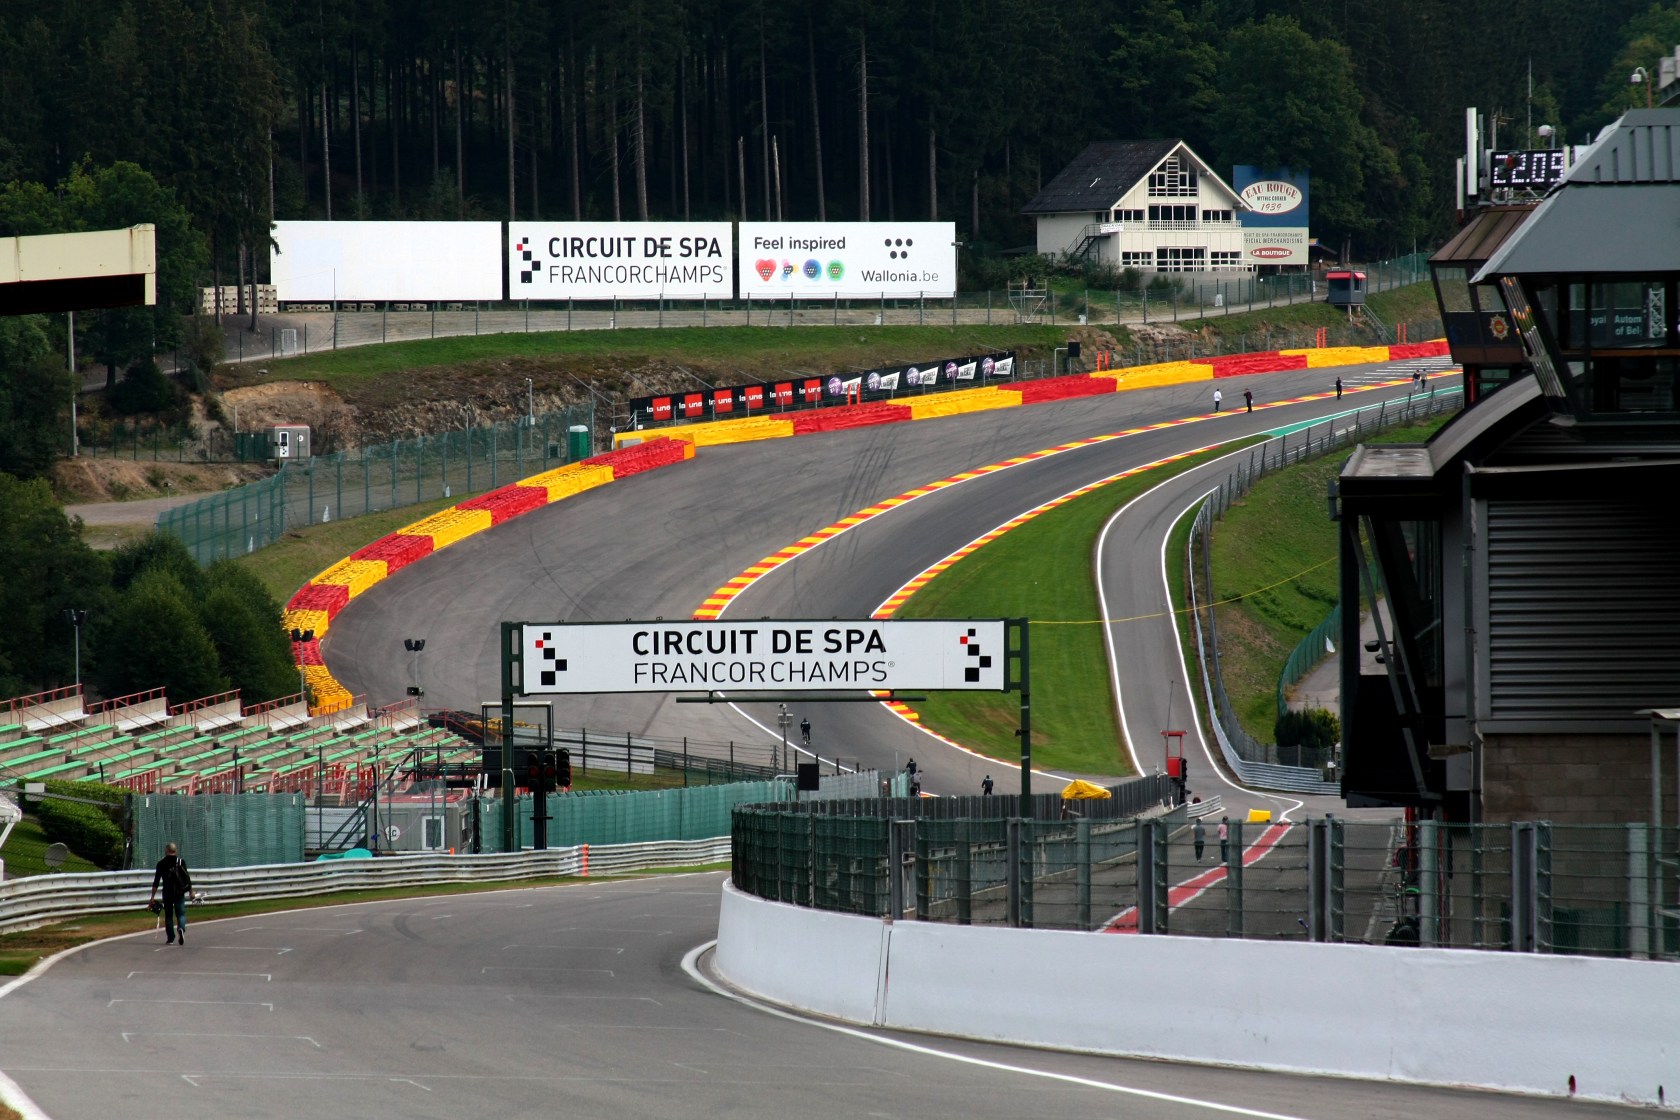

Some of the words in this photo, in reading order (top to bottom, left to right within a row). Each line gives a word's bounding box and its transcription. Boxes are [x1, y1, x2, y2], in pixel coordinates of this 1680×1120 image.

[1245, 184, 1264, 199] EAU
[1266, 183, 1298, 199] ROUGE
[1261, 203, 1282, 211] 1939
[548, 237, 637, 258] CIRCUIT
[643, 237, 673, 258] DE
[679, 237, 723, 258] SPA
[754, 236, 784, 250] Feel
[788, 236, 846, 252] inspired
[549, 265, 724, 284] FRANCORCHAMPS
[861, 270, 939, 282] Wallonia.be
[1615, 326, 1624, 335] of
[1626, 326, 1642, 335] Bel
[798, 387, 806, 395] la
[632, 630, 758, 656] CIRCUIT
[772, 629, 813, 654] DE
[823, 629, 887, 653] SPA
[634, 660, 888, 684] FRANCORCHAMPS
